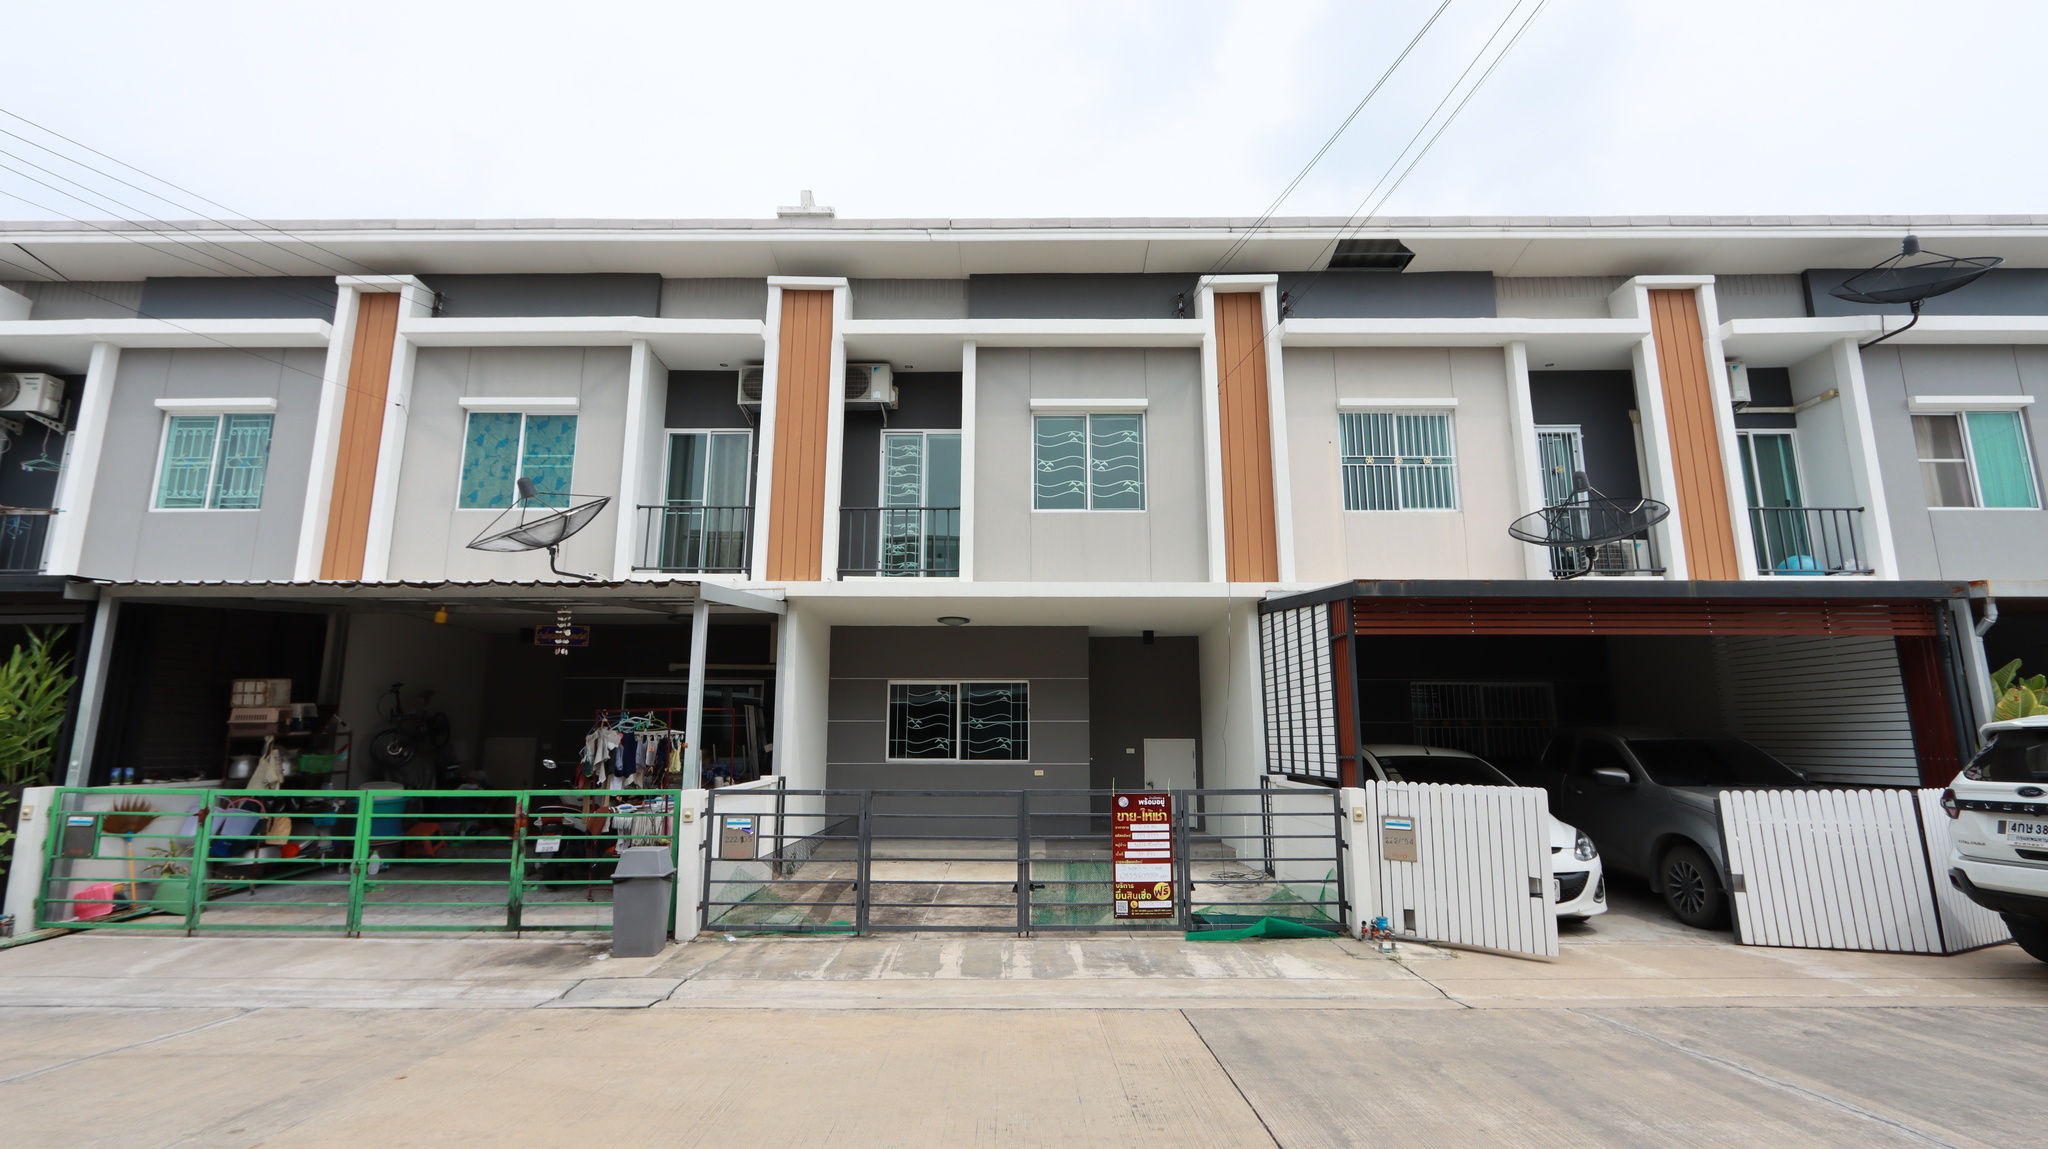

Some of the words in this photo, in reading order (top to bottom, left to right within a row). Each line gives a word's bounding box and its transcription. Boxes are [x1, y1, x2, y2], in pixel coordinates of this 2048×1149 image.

[1138, 797, 1165, 807] พร้อมอยู่
[1966, 802, 2048, 812] EVER
[1117, 808, 1167, 821] ขาย-ให้เช่า
[1115, 889, 1152, 900] ยื่นสินเชื่อ
[1154, 883, 1169, 897] ฟรี
